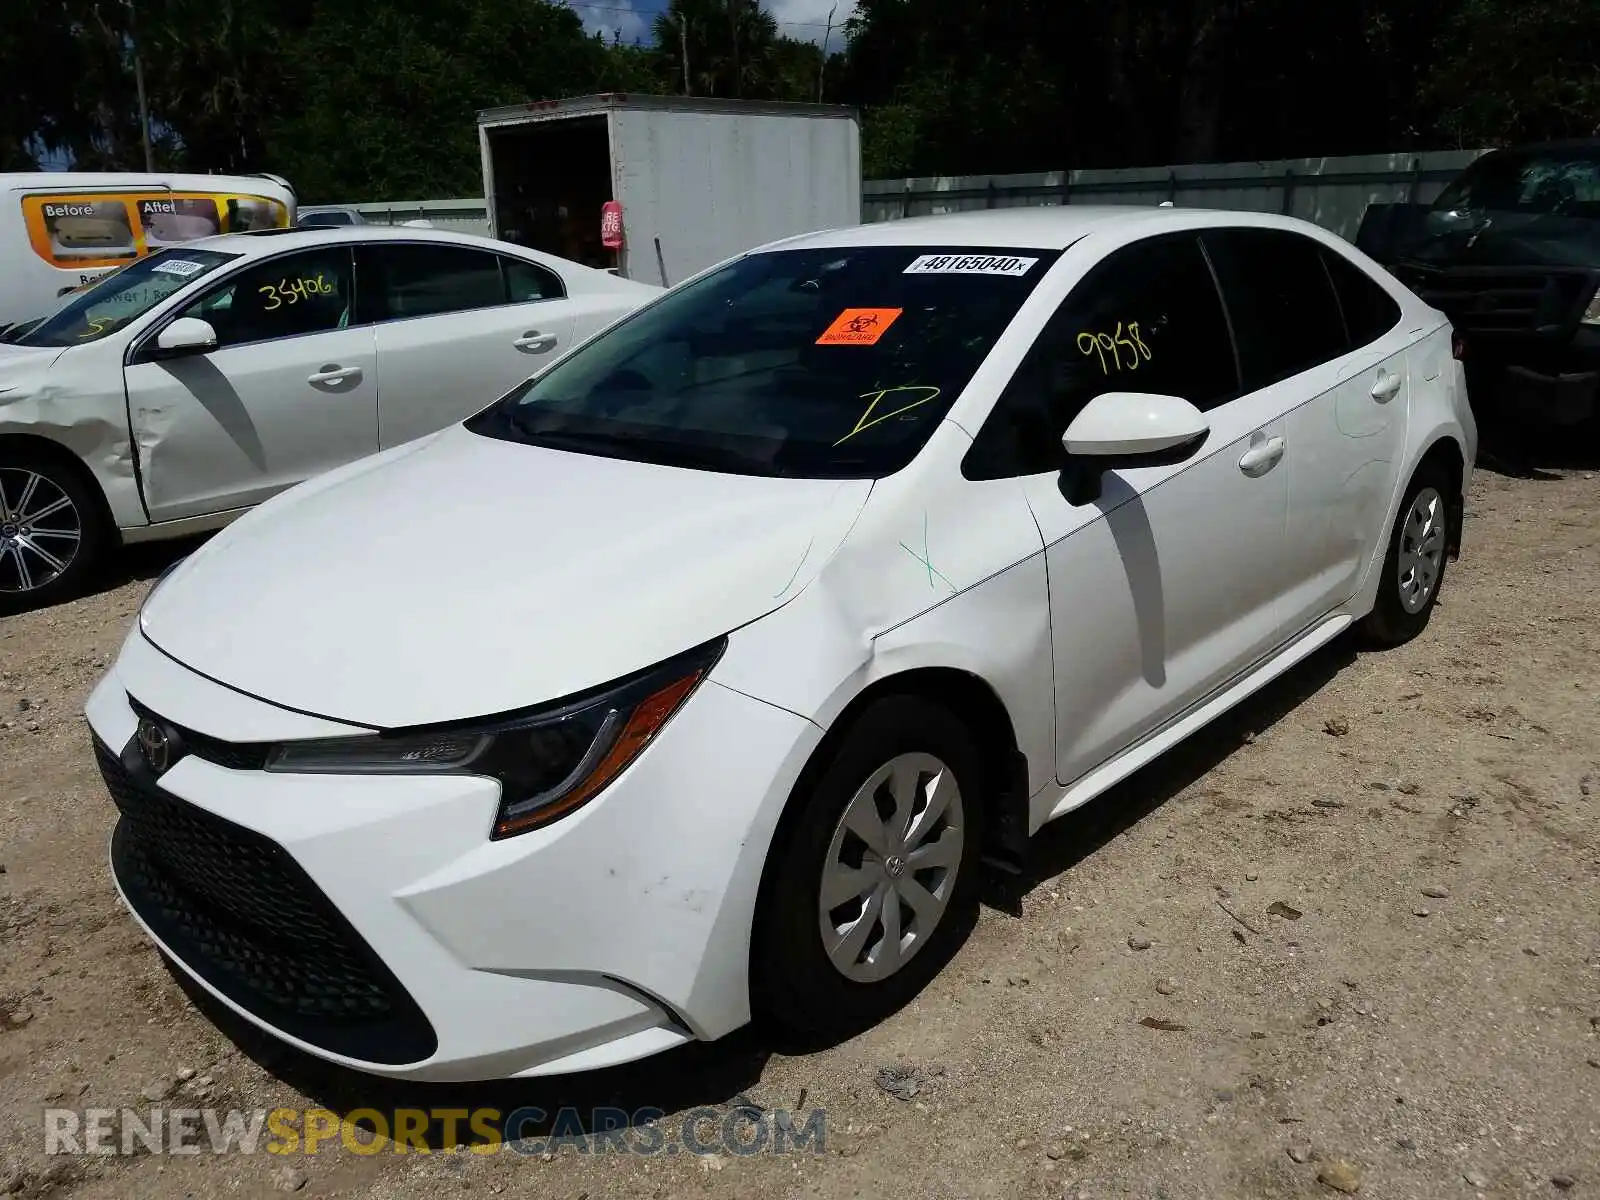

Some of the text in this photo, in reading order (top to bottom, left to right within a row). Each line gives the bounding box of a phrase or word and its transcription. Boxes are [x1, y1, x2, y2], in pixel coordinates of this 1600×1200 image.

[46, 204, 93, 216] Before
[143, 202, 176, 213] After
[258, 274, 332, 310] 35406
[1077, 321, 1151, 375] 9958
